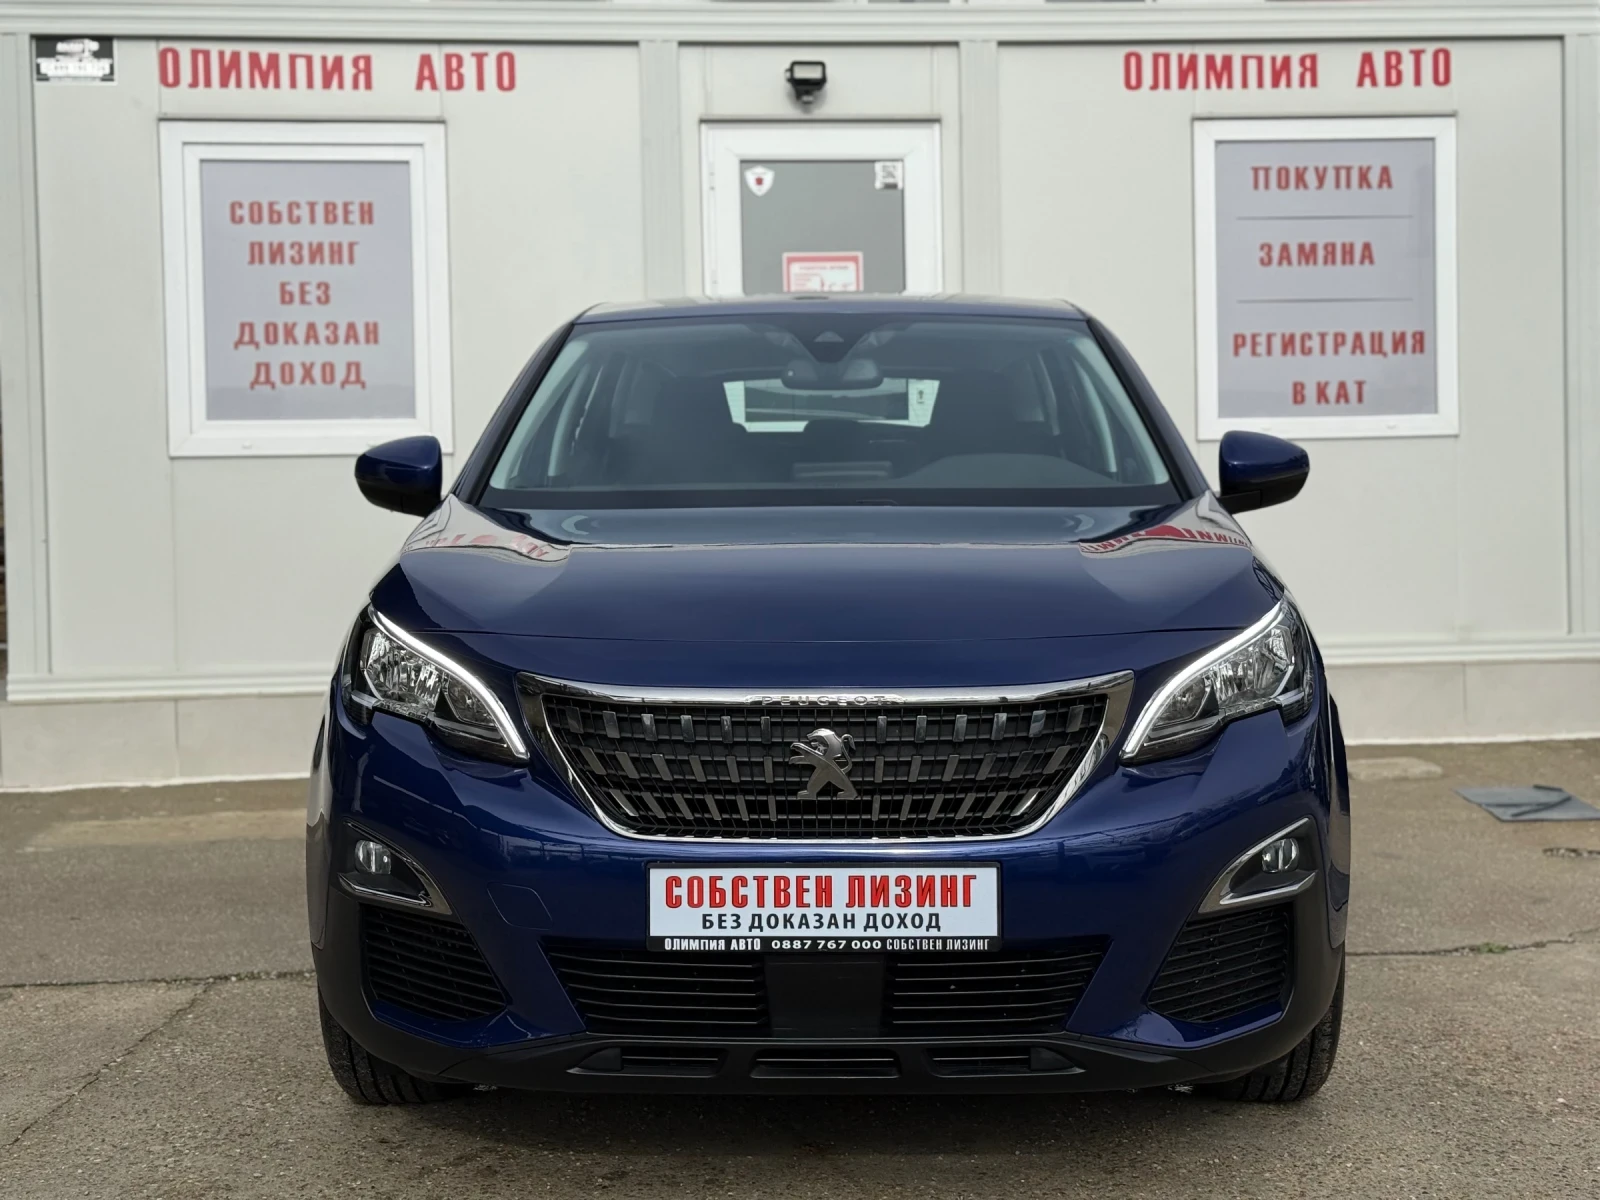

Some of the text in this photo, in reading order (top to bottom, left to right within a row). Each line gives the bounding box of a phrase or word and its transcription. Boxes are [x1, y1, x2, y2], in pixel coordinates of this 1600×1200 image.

[159, 47, 372, 90] ОЛИМПИЯ
[416, 51, 516, 91] АВТО
[1124, 48, 1451, 91] ОЛИМПИЯ АВТО
[1251, 165, 1393, 190] ПОКУПКА
[230, 201, 374, 225] СОБСТВЕН
[248, 241, 359, 265] ЛИЗИНГ
[1259, 242, 1375, 267] ЗАМЯНА
[279, 282, 331, 305] БЕЗ
[234, 322, 379, 350] ДОКАЗАН
[1233, 331, 1426, 358] РЕГИСТРАЦИЯ
[250, 361, 366, 390] ДОХОД
[1292, 380, 1367, 405] В КАТ
[762, 695, 886, 706] PEUGEOT
[665, 874, 976, 908] СОБСТВЕН ЛИЗИНГ
[702, 913, 940, 932] БЕЗ ДОКАЗАН ДОХОД
[665, 938, 990, 950] ОЛИМПИЯ АВТО 0887 767 000 СОБСТВЕН ЛИЗИНГ
